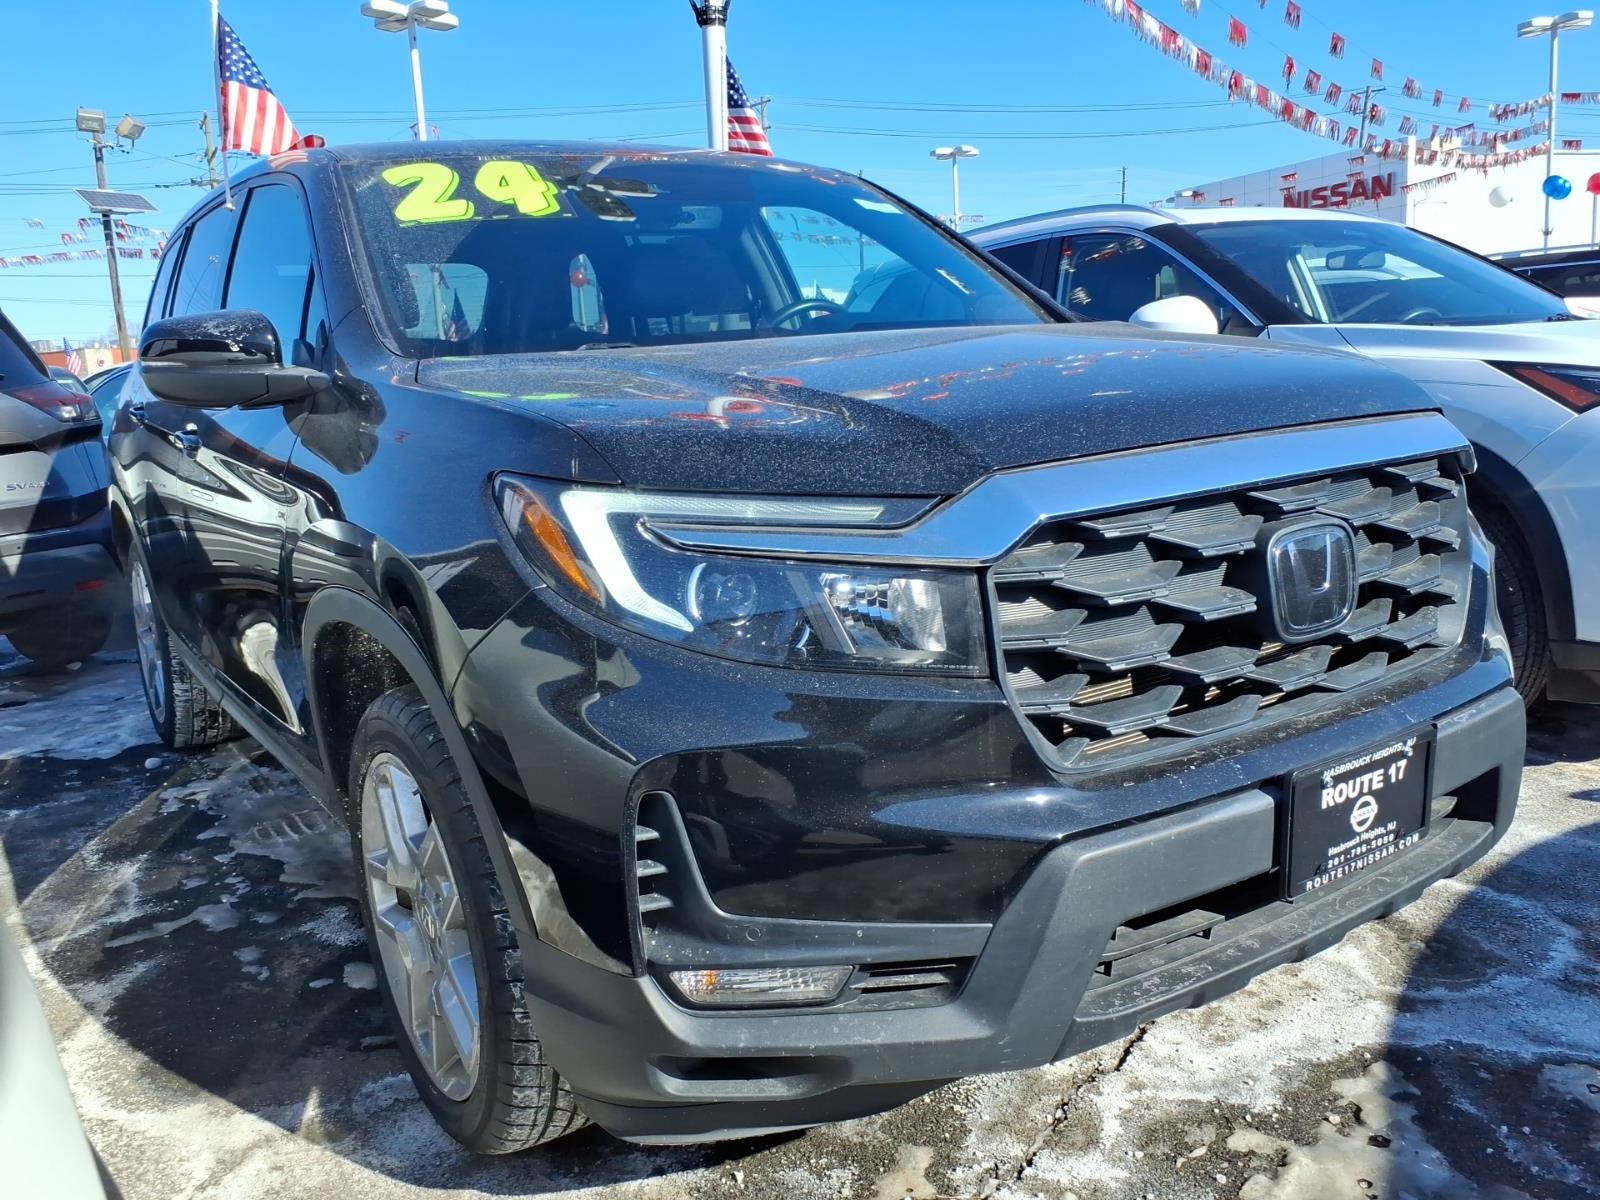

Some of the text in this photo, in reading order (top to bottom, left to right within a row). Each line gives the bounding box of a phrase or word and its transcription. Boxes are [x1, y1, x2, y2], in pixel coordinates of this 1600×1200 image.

[382, 161, 560, 223] 24
[1283, 173, 1392, 208] NISSAN
[1321, 759, 1408, 809] ROUTE 17
[1323, 754, 1372, 779] HASBROUCK
[1328, 820, 1397, 856] Hasbrouck Heights, NJ
[1306, 832, 1420, 891] ROUTE17NISSAN.COM
